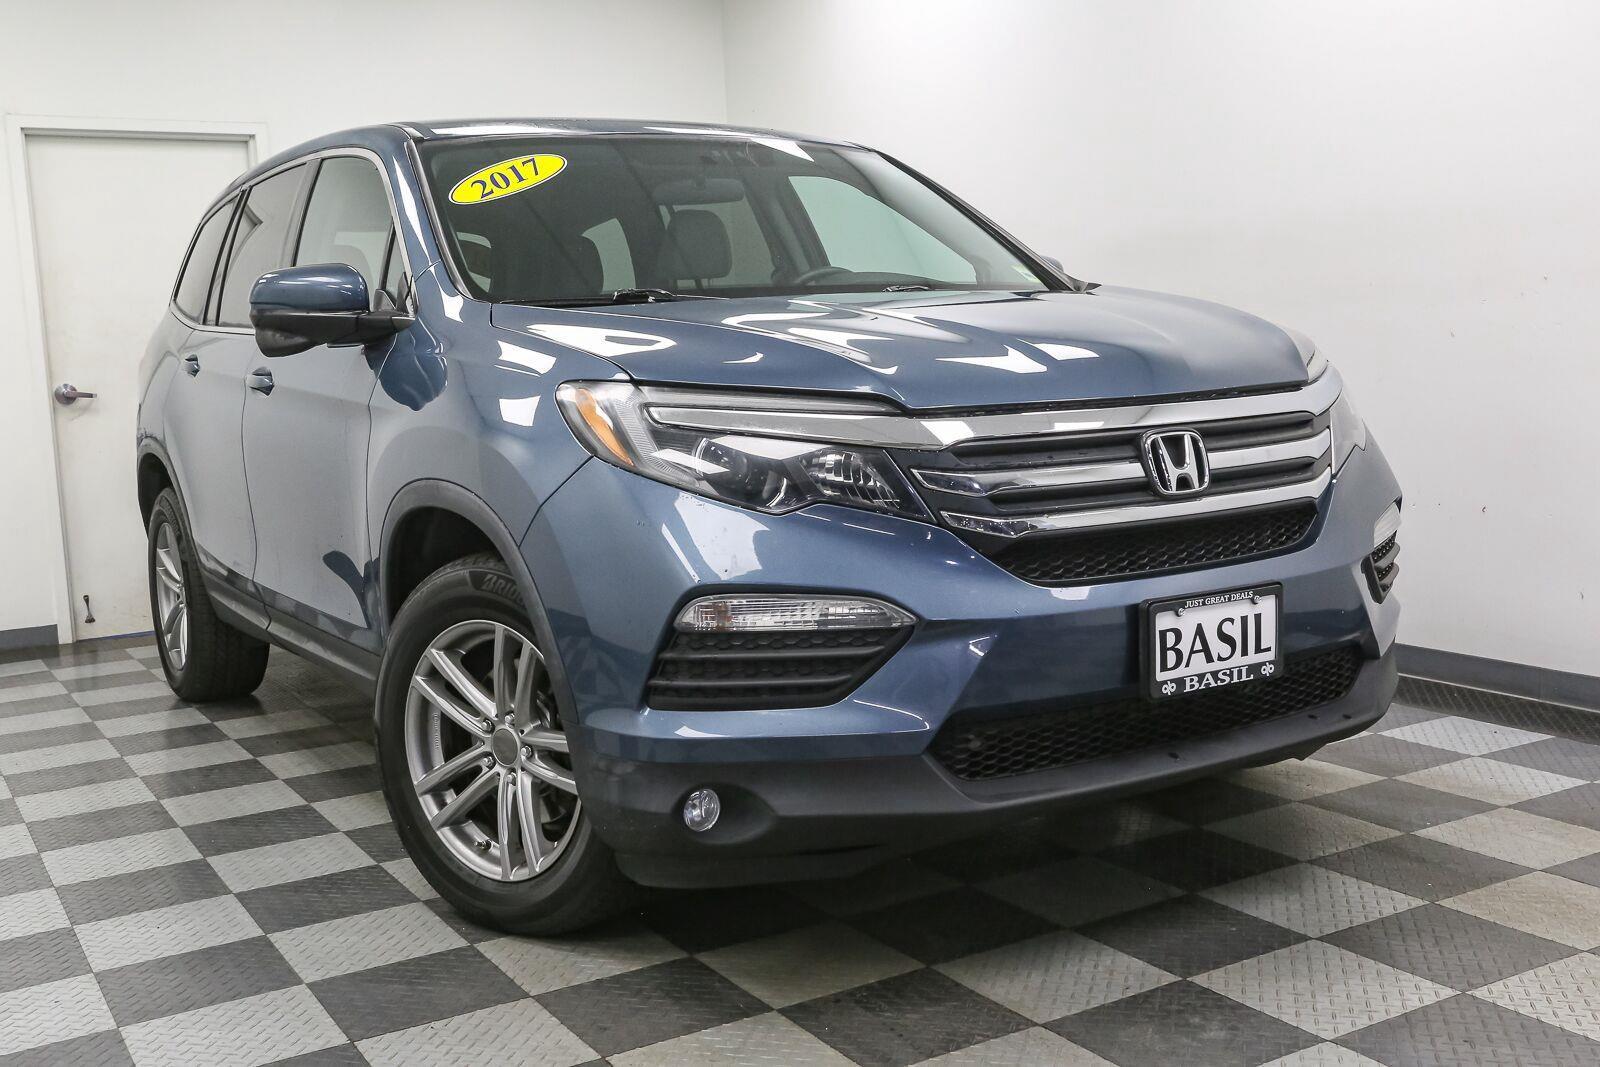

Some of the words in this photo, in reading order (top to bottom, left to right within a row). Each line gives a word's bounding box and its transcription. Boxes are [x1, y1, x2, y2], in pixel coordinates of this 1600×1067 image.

[470, 157, 539, 199] 2017
[1184, 598, 1204, 609] JUST
[1205, 594, 1230, 605] GREAT
[1230, 591, 1254, 601] DEALS
[1158, 612, 1272, 674] BASIL
[1183, 665, 1254, 693] BASIL
